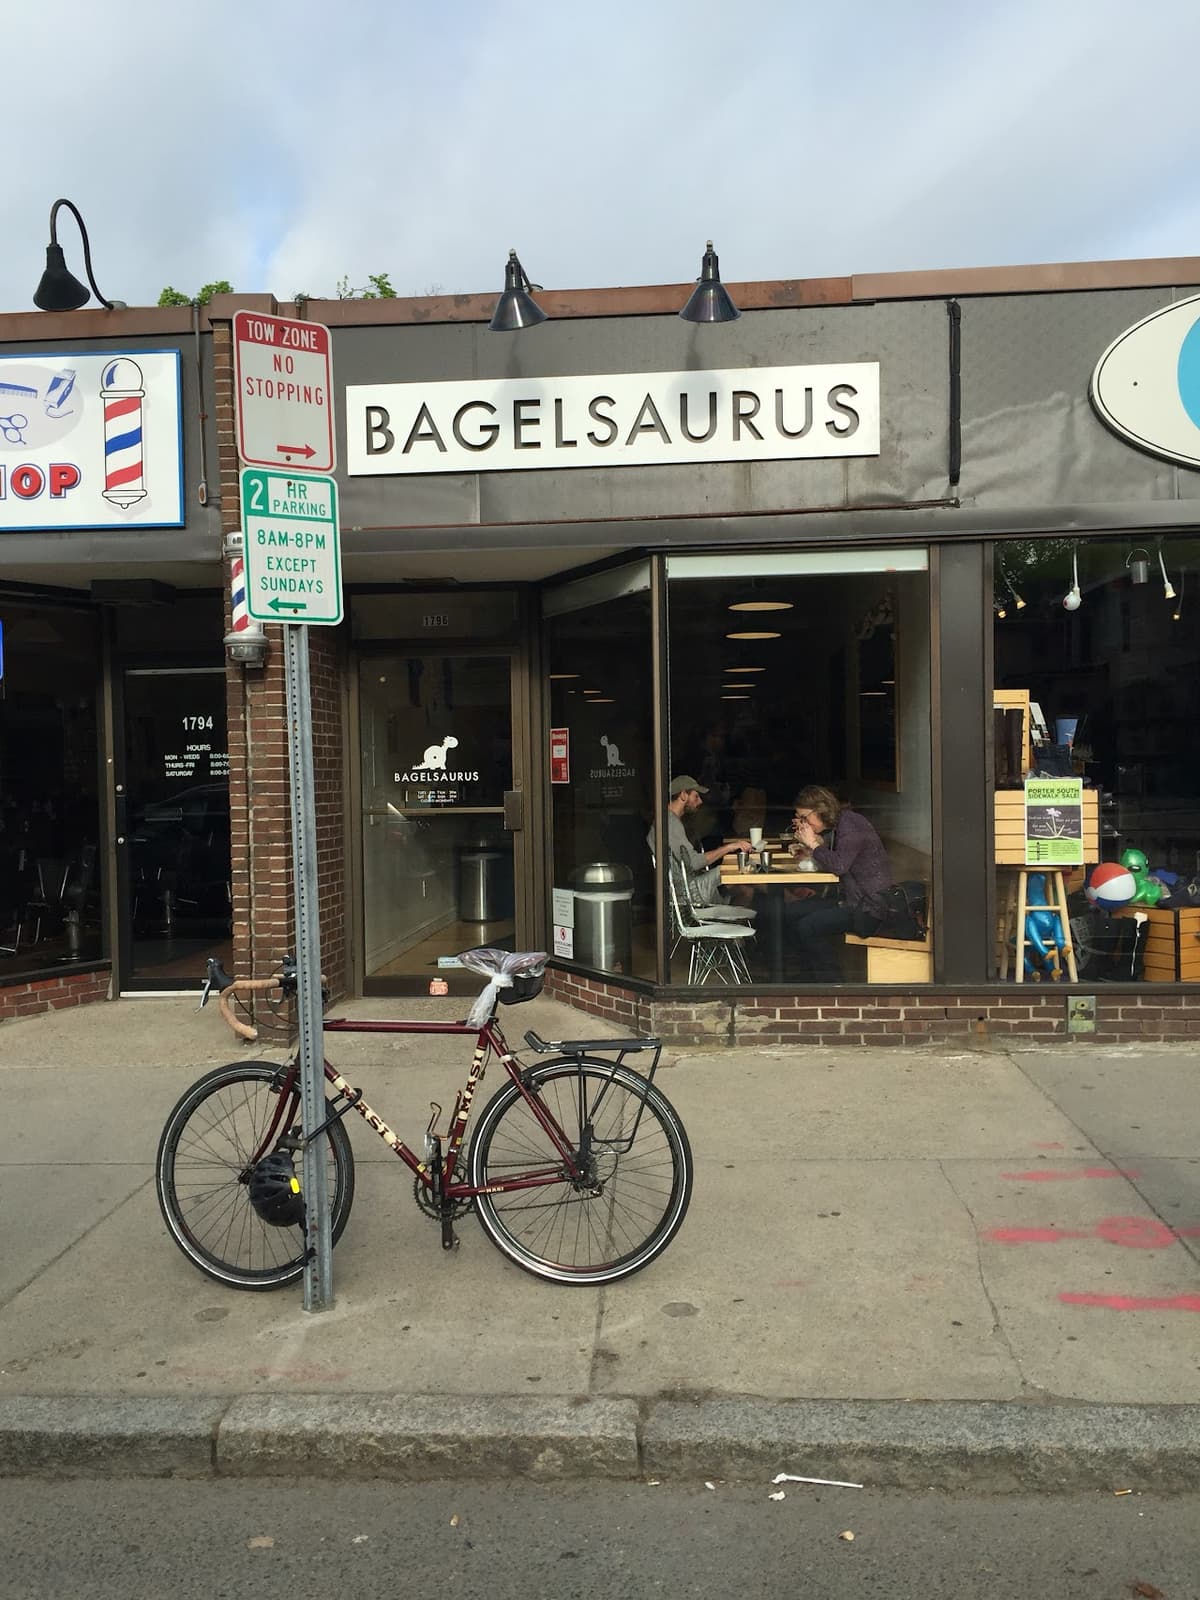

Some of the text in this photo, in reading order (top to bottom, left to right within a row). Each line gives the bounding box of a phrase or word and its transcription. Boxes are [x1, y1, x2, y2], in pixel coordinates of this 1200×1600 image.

[247, 319, 318, 350] TOW ZONE
[273, 353, 294, 375] NO
[246, 377, 323, 406] STOPPING
[366, 383, 861, 456] BAGELSAURUS
[0, 463, 81, 499] OP
[249, 478, 308, 511] 2 HR
[273, 499, 326, 517] PARKING
[257, 529, 326, 550] 8AM-8PM
[267, 556, 316, 574] EXCEPT
[260, 576, 323, 594] SUNDAYS
[182, 715, 213, 731] 1794
[186, 744, 211, 752] HOURS
[394, 772, 479, 782] BAGELSAURUS
